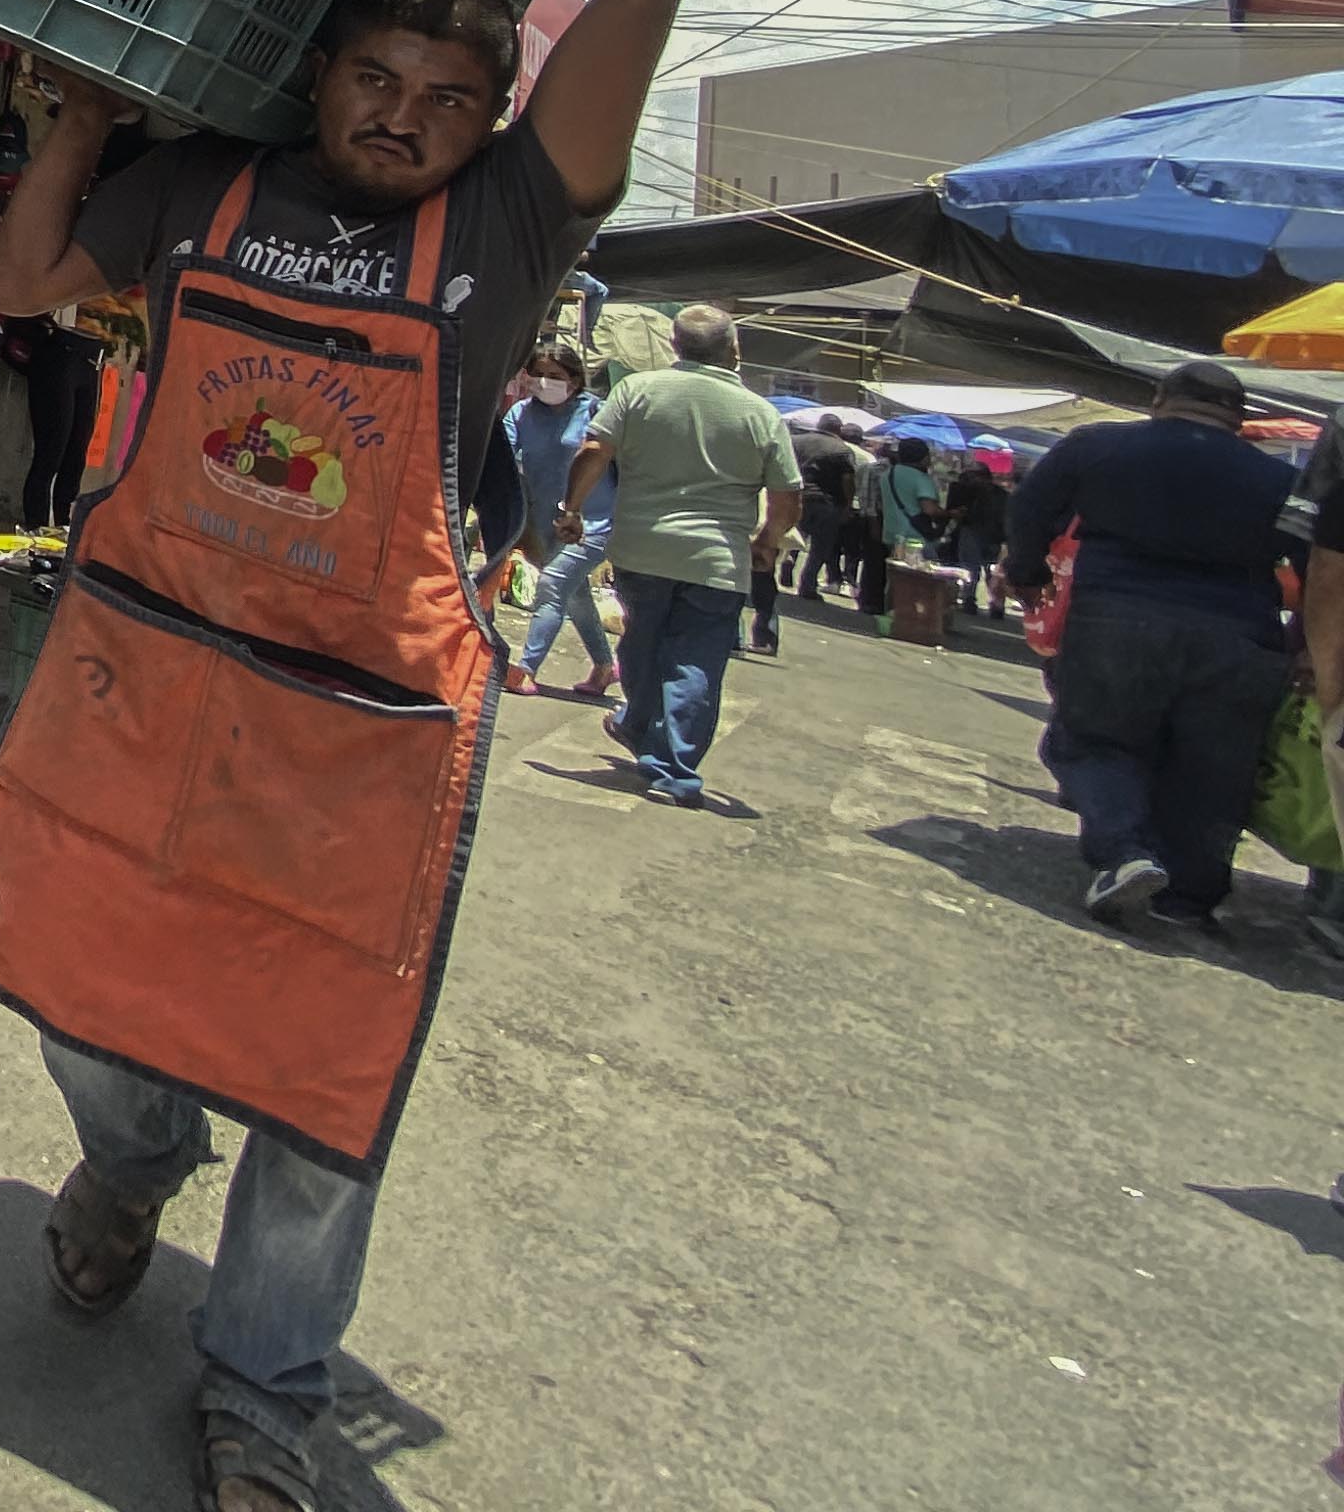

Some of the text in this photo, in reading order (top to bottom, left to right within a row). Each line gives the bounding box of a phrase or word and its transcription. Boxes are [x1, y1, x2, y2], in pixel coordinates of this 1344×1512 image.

[197, 355, 385, 449] FRUTAS FINAS
[286, 535, 337, 576] AÑO
